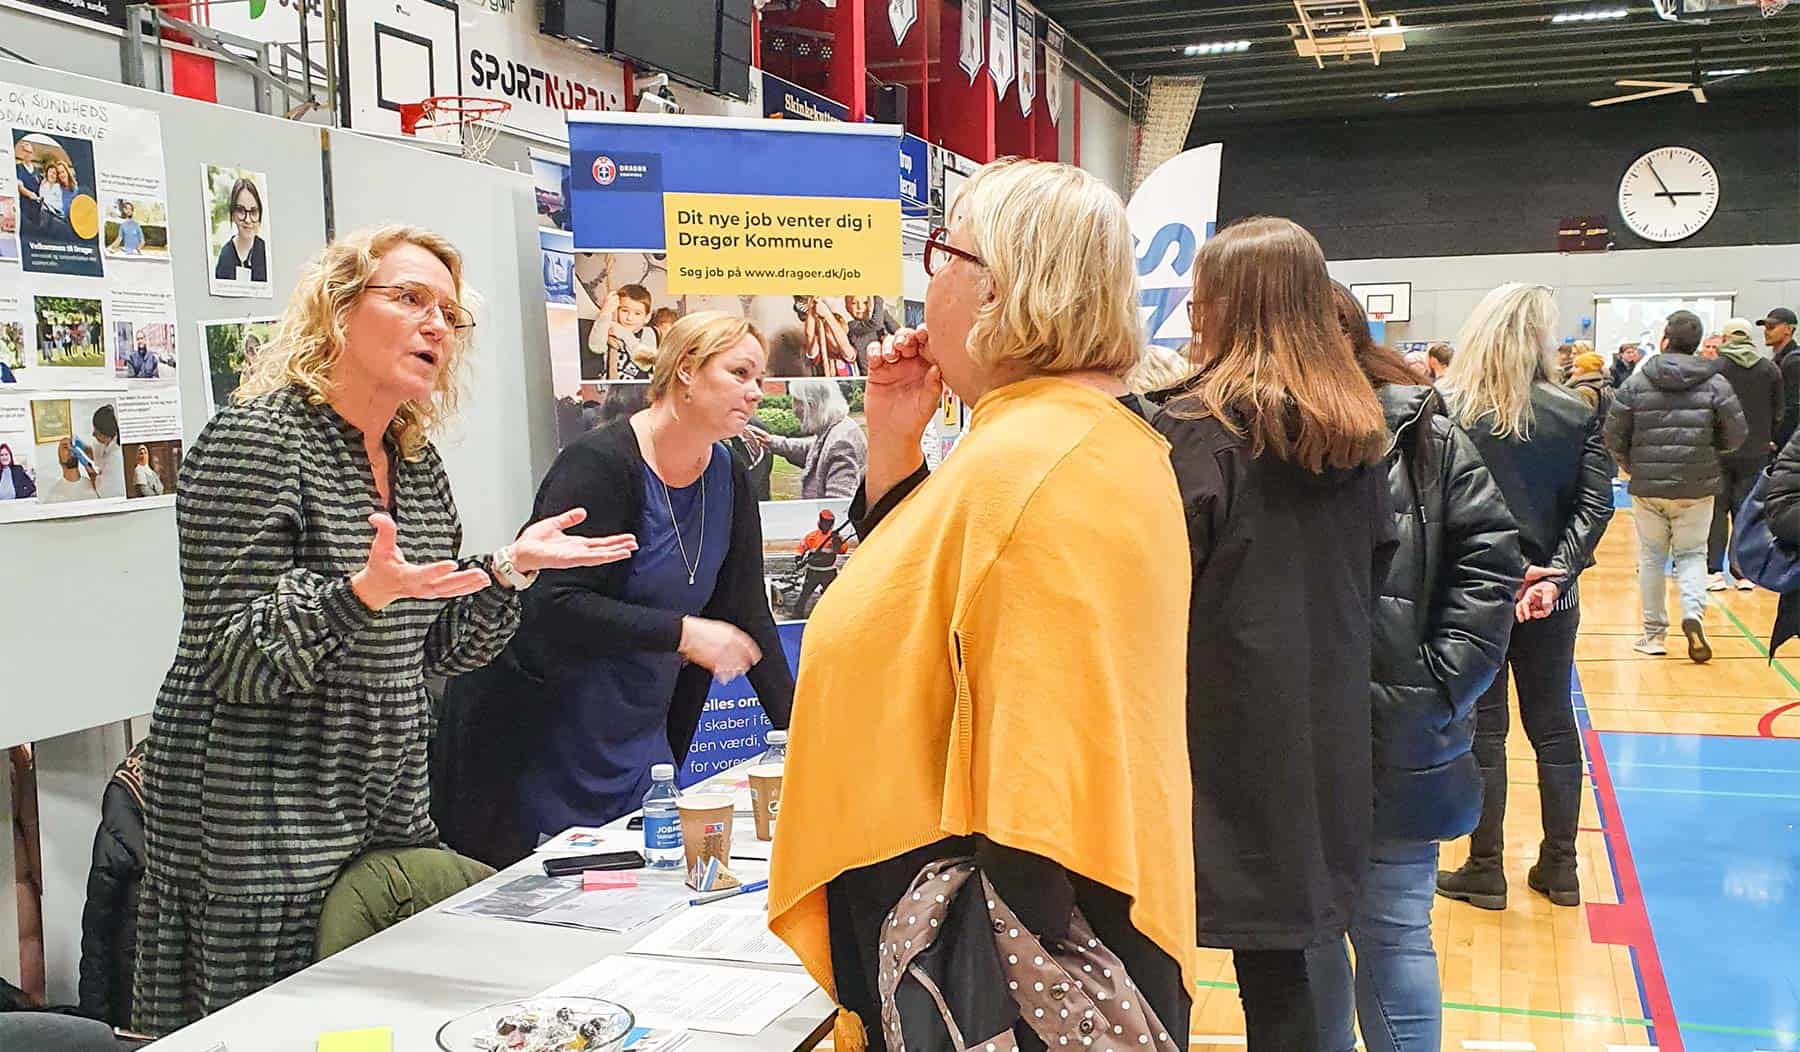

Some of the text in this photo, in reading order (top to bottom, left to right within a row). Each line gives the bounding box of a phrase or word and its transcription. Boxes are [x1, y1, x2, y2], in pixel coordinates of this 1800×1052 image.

[32, 94, 109, 123] SUNDHEDS
[678, 209, 872, 231] Dit nye job venter dig i
[679, 232, 833, 250] Dragør Kommune
[680, 266, 862, 280] Søg job på www.dragoer.dk/job
[705, 716, 750, 731] skaber
[752, 714, 757, 726] i
[689, 740, 717, 752] den
[719, 734, 761, 749] værdi,
[690, 760, 709, 773] for
